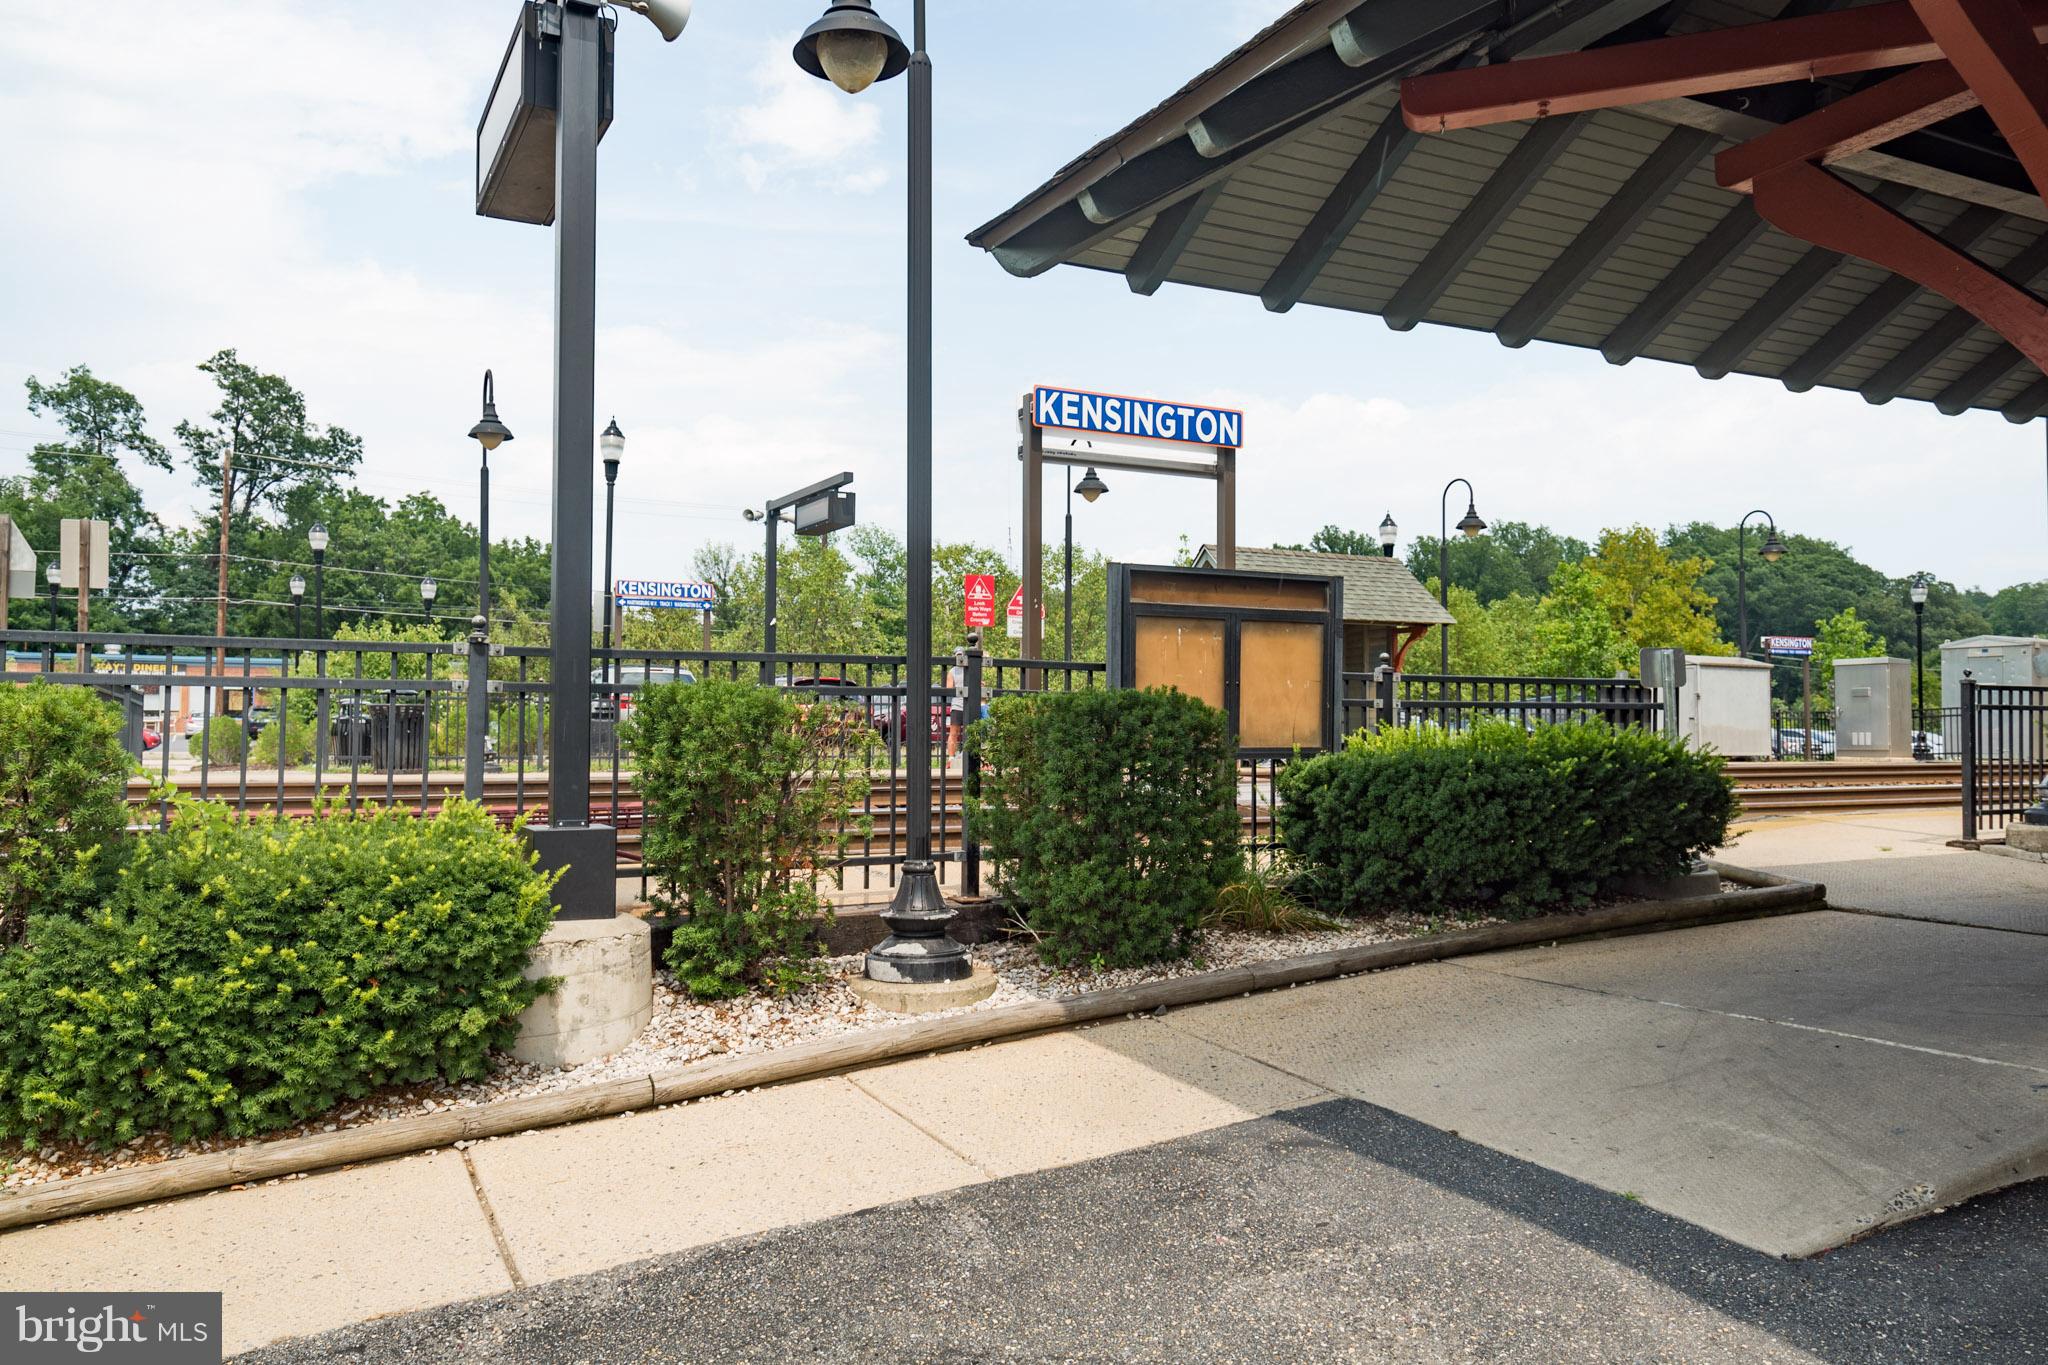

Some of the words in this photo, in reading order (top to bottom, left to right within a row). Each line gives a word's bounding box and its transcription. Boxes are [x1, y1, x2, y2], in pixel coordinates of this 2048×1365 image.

[1039, 390, 1238, 445] KENSINGTON
[618, 581, 712, 598] KENSINGTON
[1771, 638, 1812, 648] KENSINGTON
[133, 663, 166, 672] DINER
